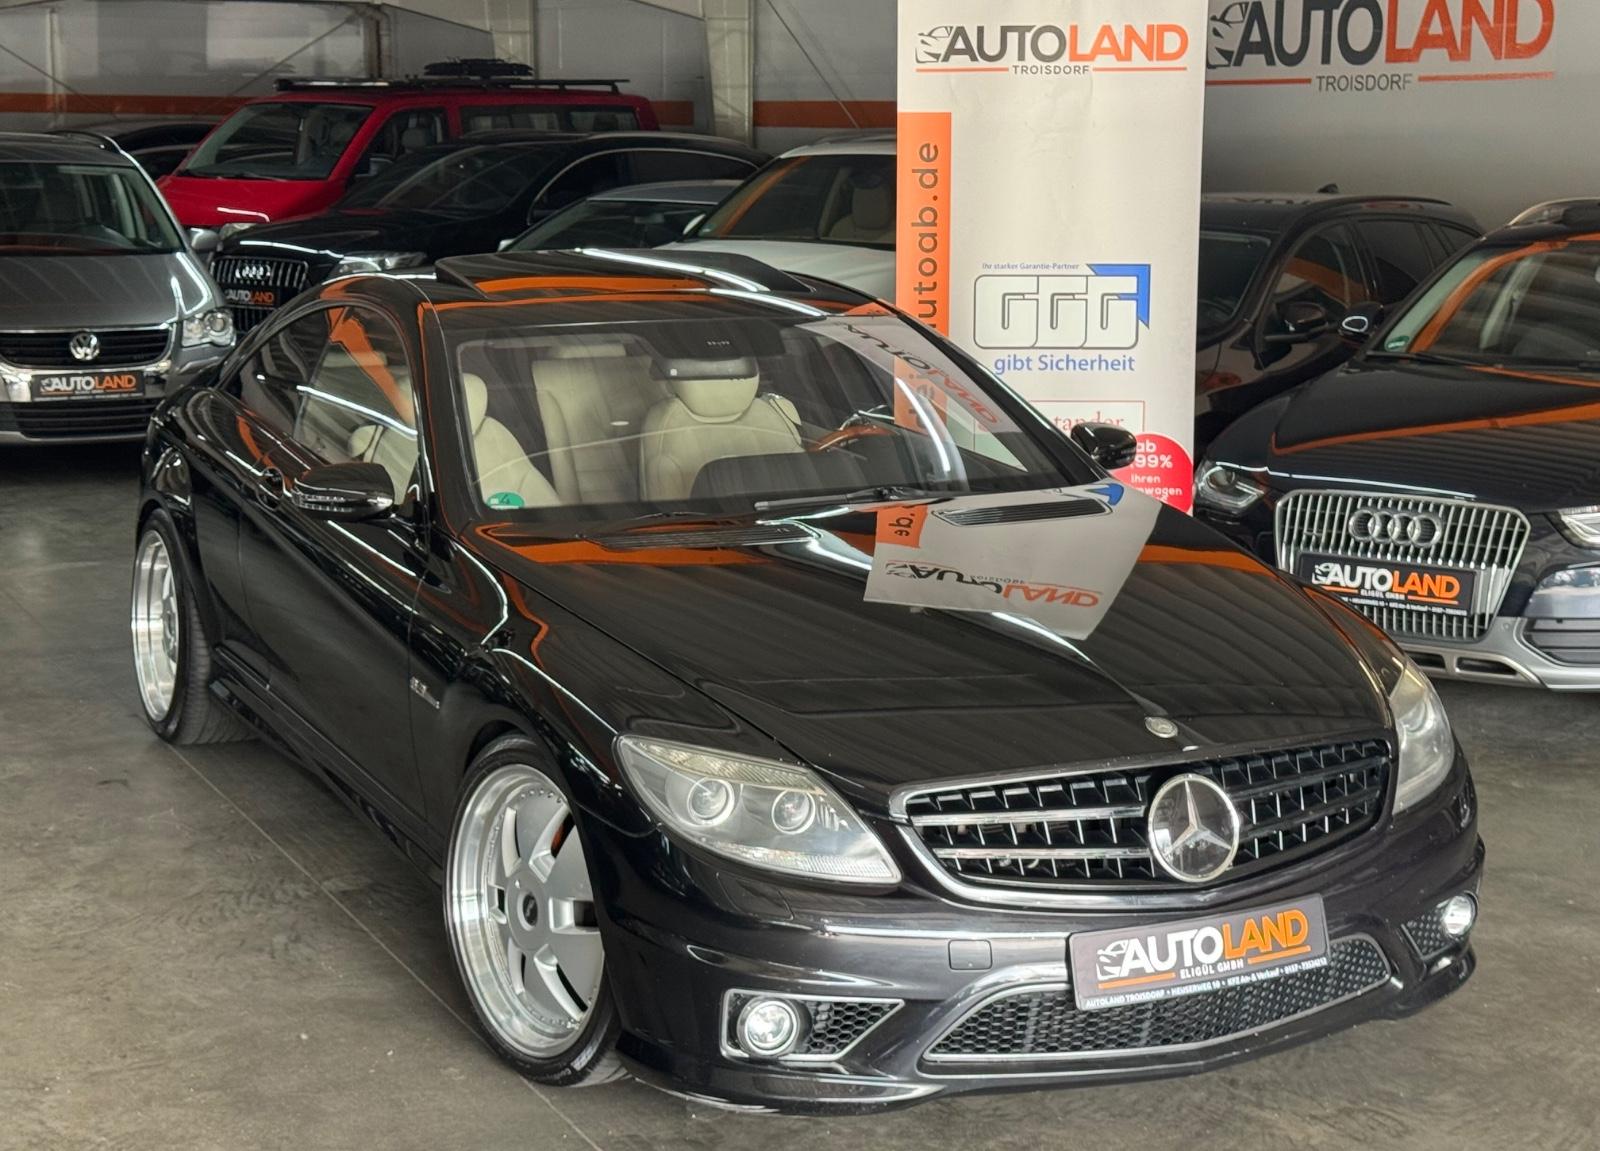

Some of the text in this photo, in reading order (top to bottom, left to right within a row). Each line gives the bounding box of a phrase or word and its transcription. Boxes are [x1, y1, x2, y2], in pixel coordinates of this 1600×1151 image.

[1232, 0, 1556, 67] AUTOLAND
[940, 24, 1189, 63] AUTOLAND
[1012, 64, 1090, 75] TROISDORF
[1315, 73, 1413, 92] TROISDORF
[911, 142, 939, 329] utoab.de
[982, 262, 993, 270] Ihr
[1019, 262, 1080, 270] Garantie-Partner
[993, 354, 1135, 375] gibt Sicherheit
[50, 374, 137, 392] AUTOLAND
[1136, 439, 1157, 453] ab
[1130, 473, 1161, 484] Ihren
[1326, 562, 1461, 599] AUTOLAND
[1119, 909, 1310, 978] AUTOLAND
[1179, 963, 1215, 980] ELIGÜL
